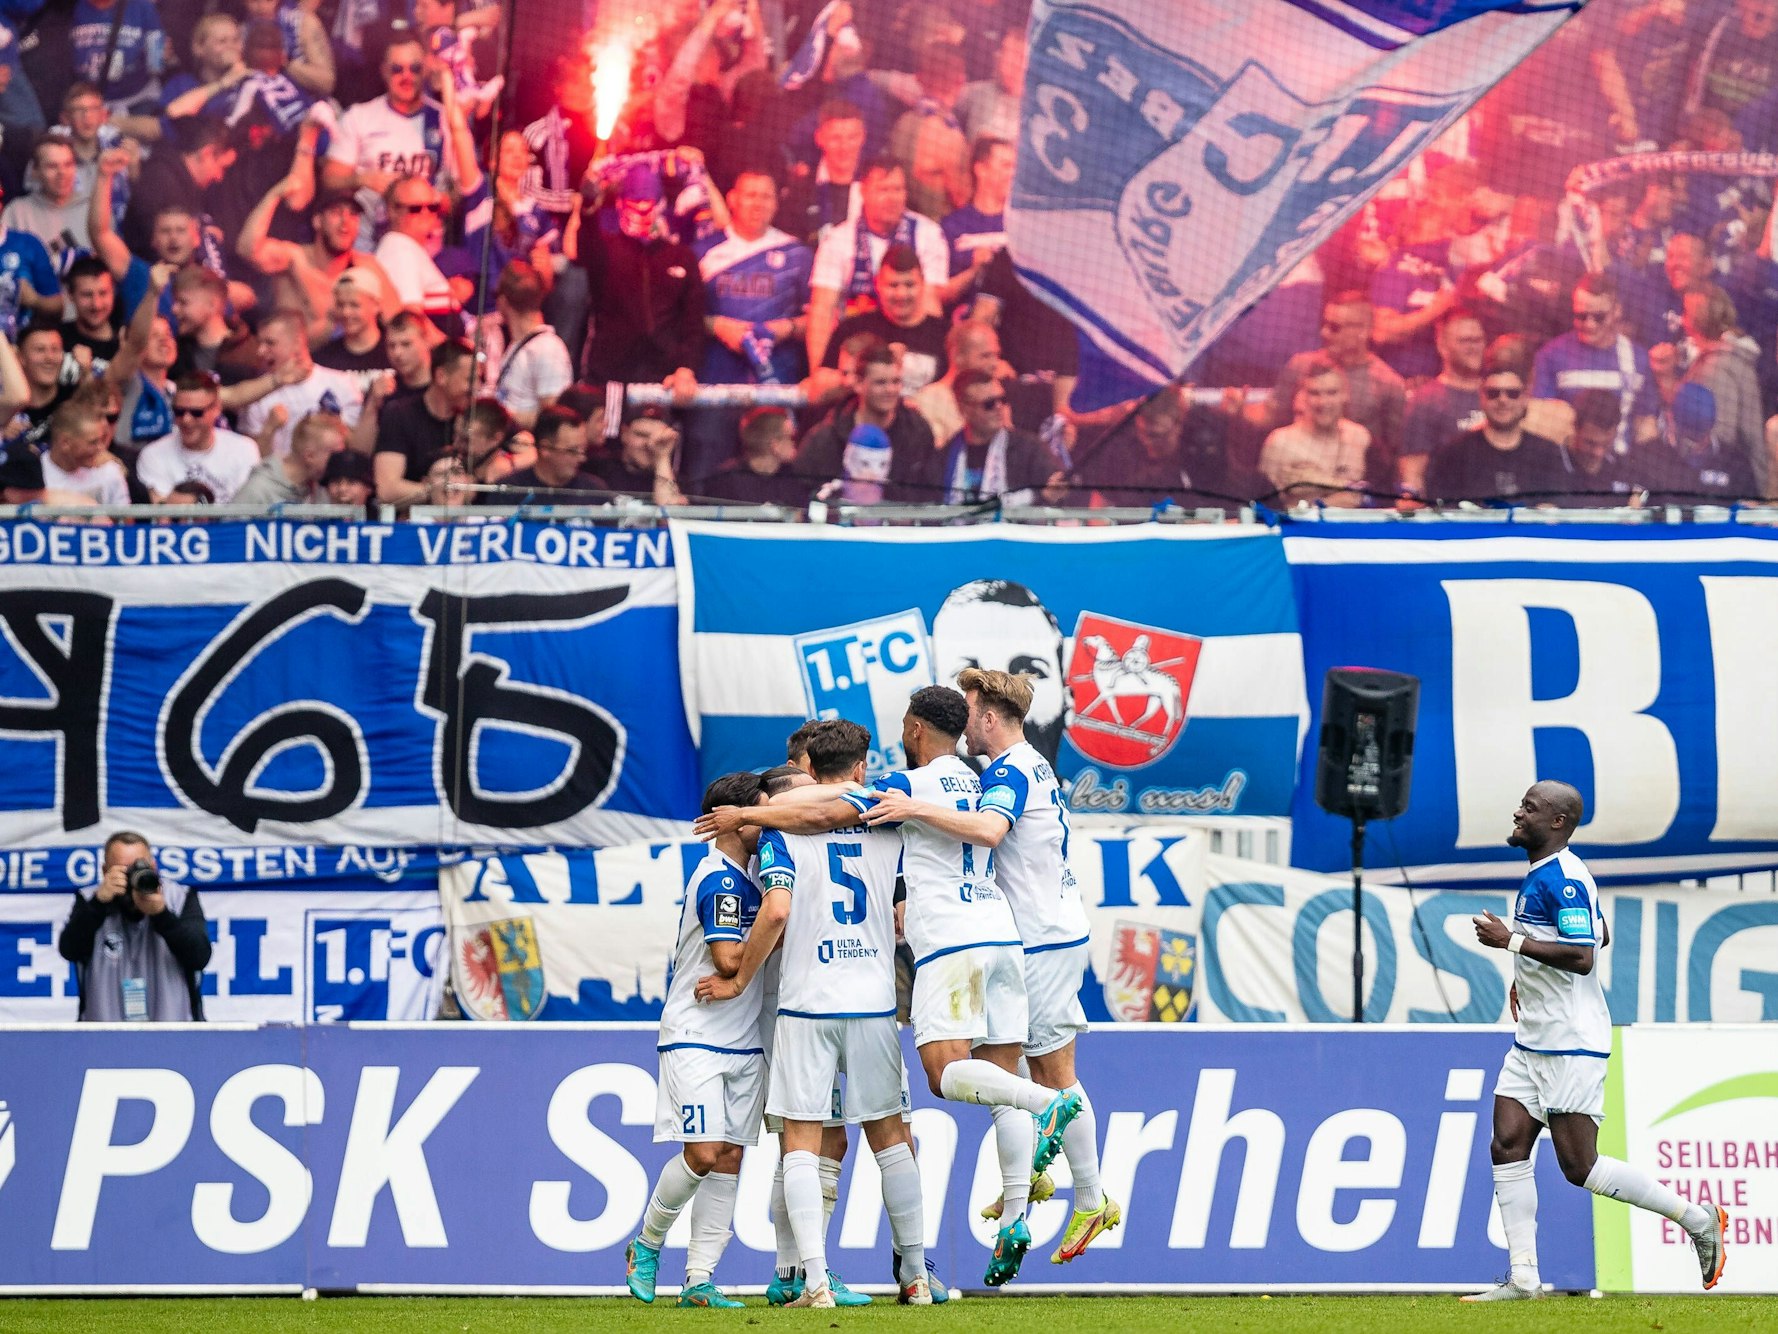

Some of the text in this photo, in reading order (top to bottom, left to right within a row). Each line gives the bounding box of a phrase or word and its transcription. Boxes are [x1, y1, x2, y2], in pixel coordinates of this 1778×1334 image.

[245, 526, 393, 563] NICHT
[418, 526, 667, 567] VERLOREN
[806, 631, 919, 692] 1.FC
[0, 850, 49, 888] IE
[66, 847, 318, 885] GSSTEN
[827, 843, 867, 926] 5
[719, 914, 738, 925] bwin
[1562, 915, 1586, 925] SWM
[837, 939, 862, 949] ULTRA
[837, 949, 878, 958] TENDENCY
[682, 1105, 705, 1133] 21
[51, 1063, 480, 1254] PSK
[1658, 1141, 1778, 1168] SEILBAH
